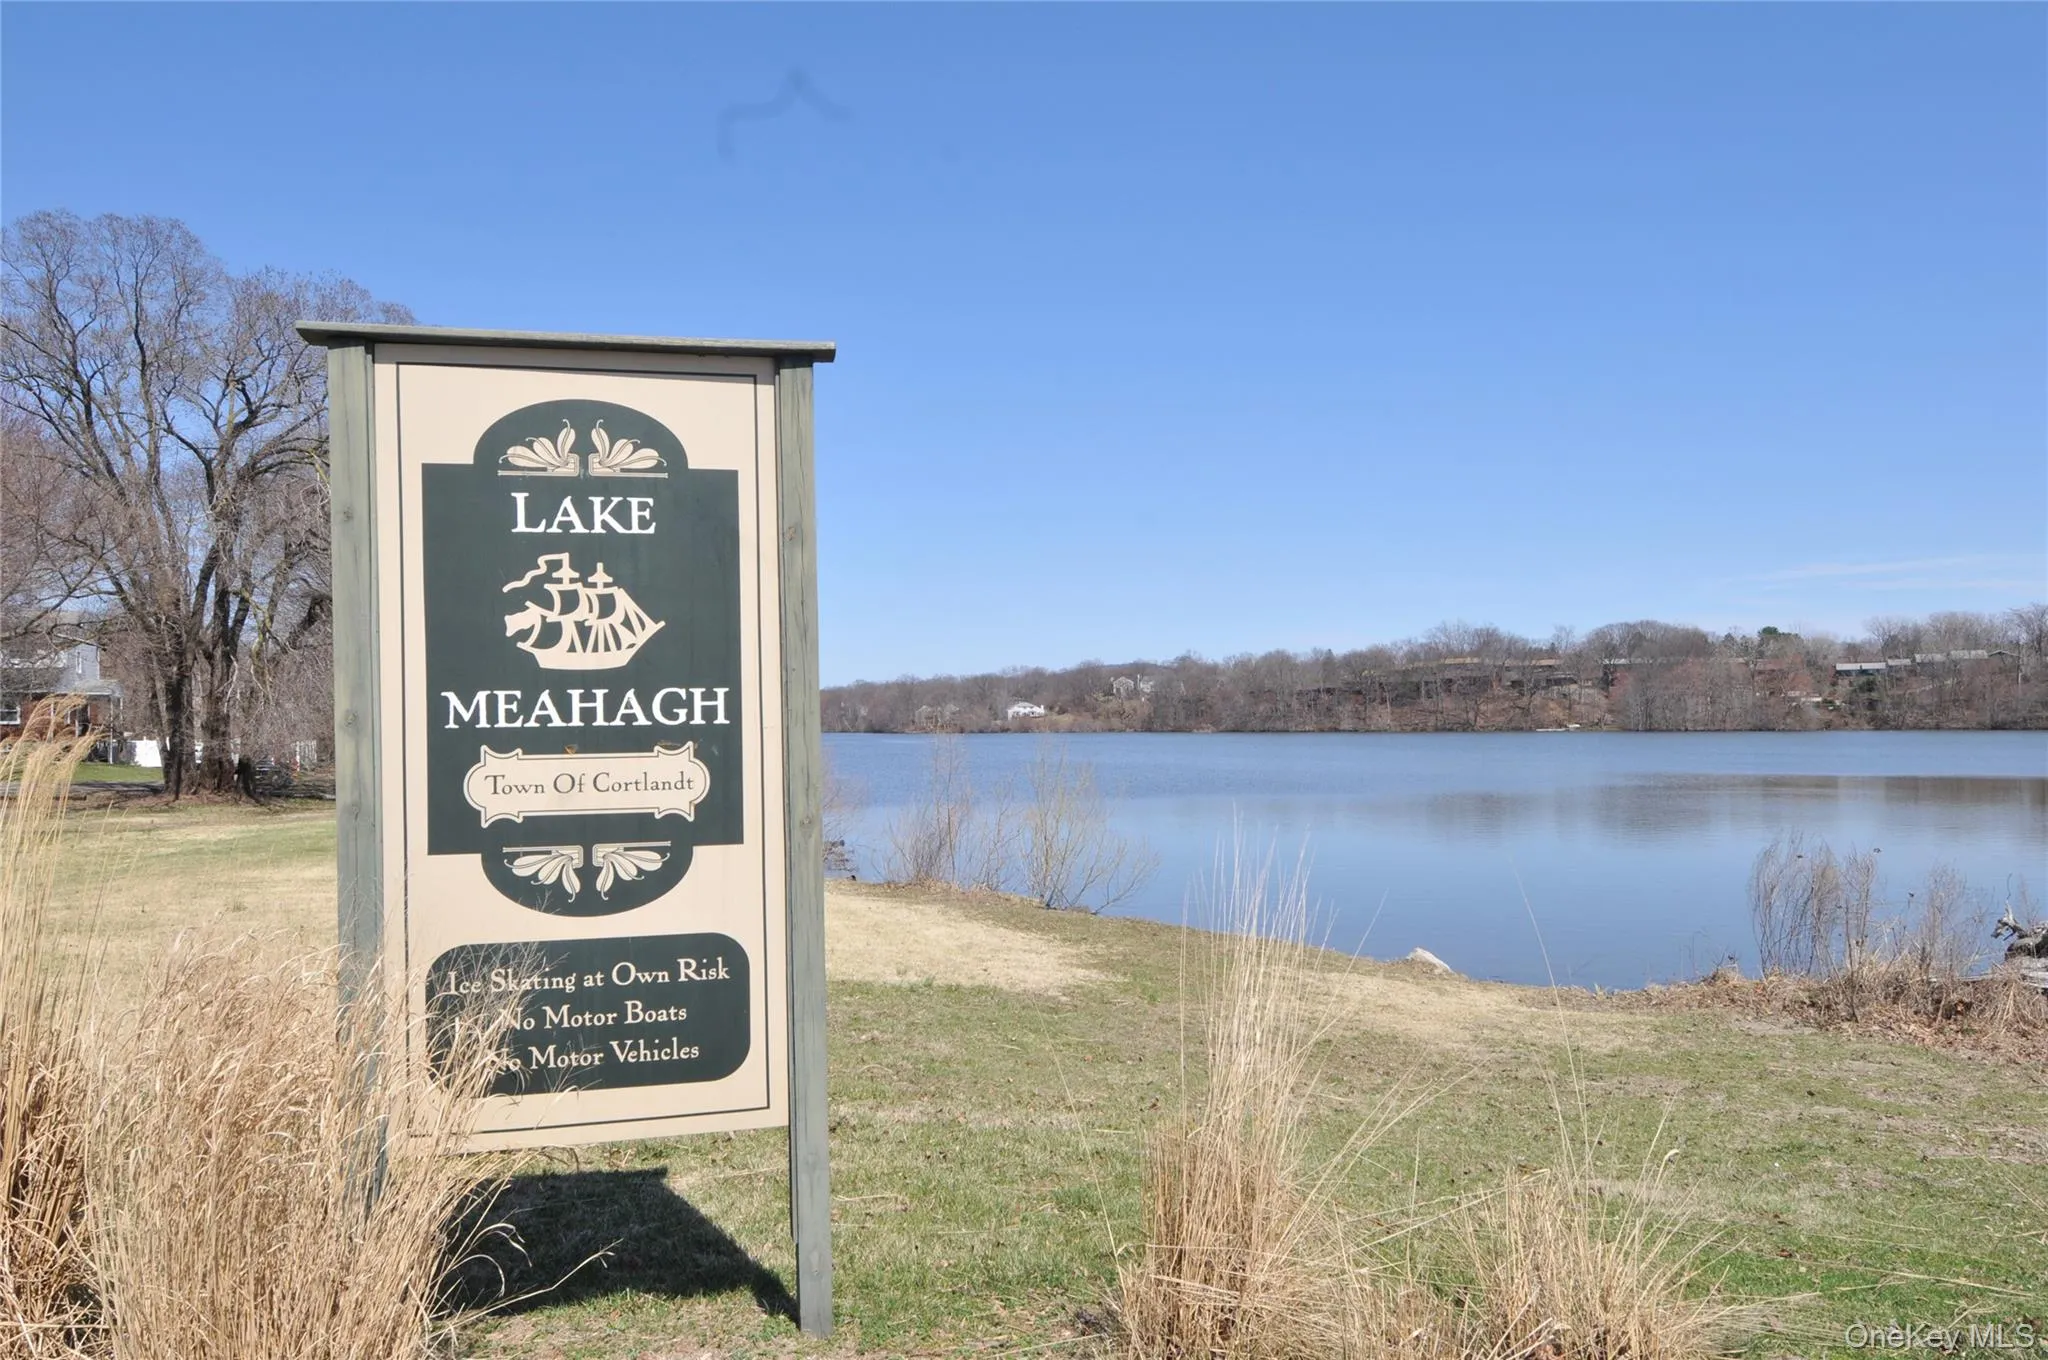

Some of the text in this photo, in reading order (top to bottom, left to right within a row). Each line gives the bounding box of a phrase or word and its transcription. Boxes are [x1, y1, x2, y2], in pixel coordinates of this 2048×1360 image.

[511, 492, 657, 535] LAKE
[441, 687, 730, 729] MEAHAGH
[484, 769, 695, 796] Town Of Cortlandt
[490, 969, 578, 994] Skating
[583, 972, 605, 988] at
[611, 962, 671, 987] Own
[676, 957, 731, 982] Risk
[543, 1004, 618, 1030] Motor
[623, 1000, 688, 1025] Boats
[531, 1045, 605, 1072] Motor
[609, 1037, 700, 1064] Vehicles
